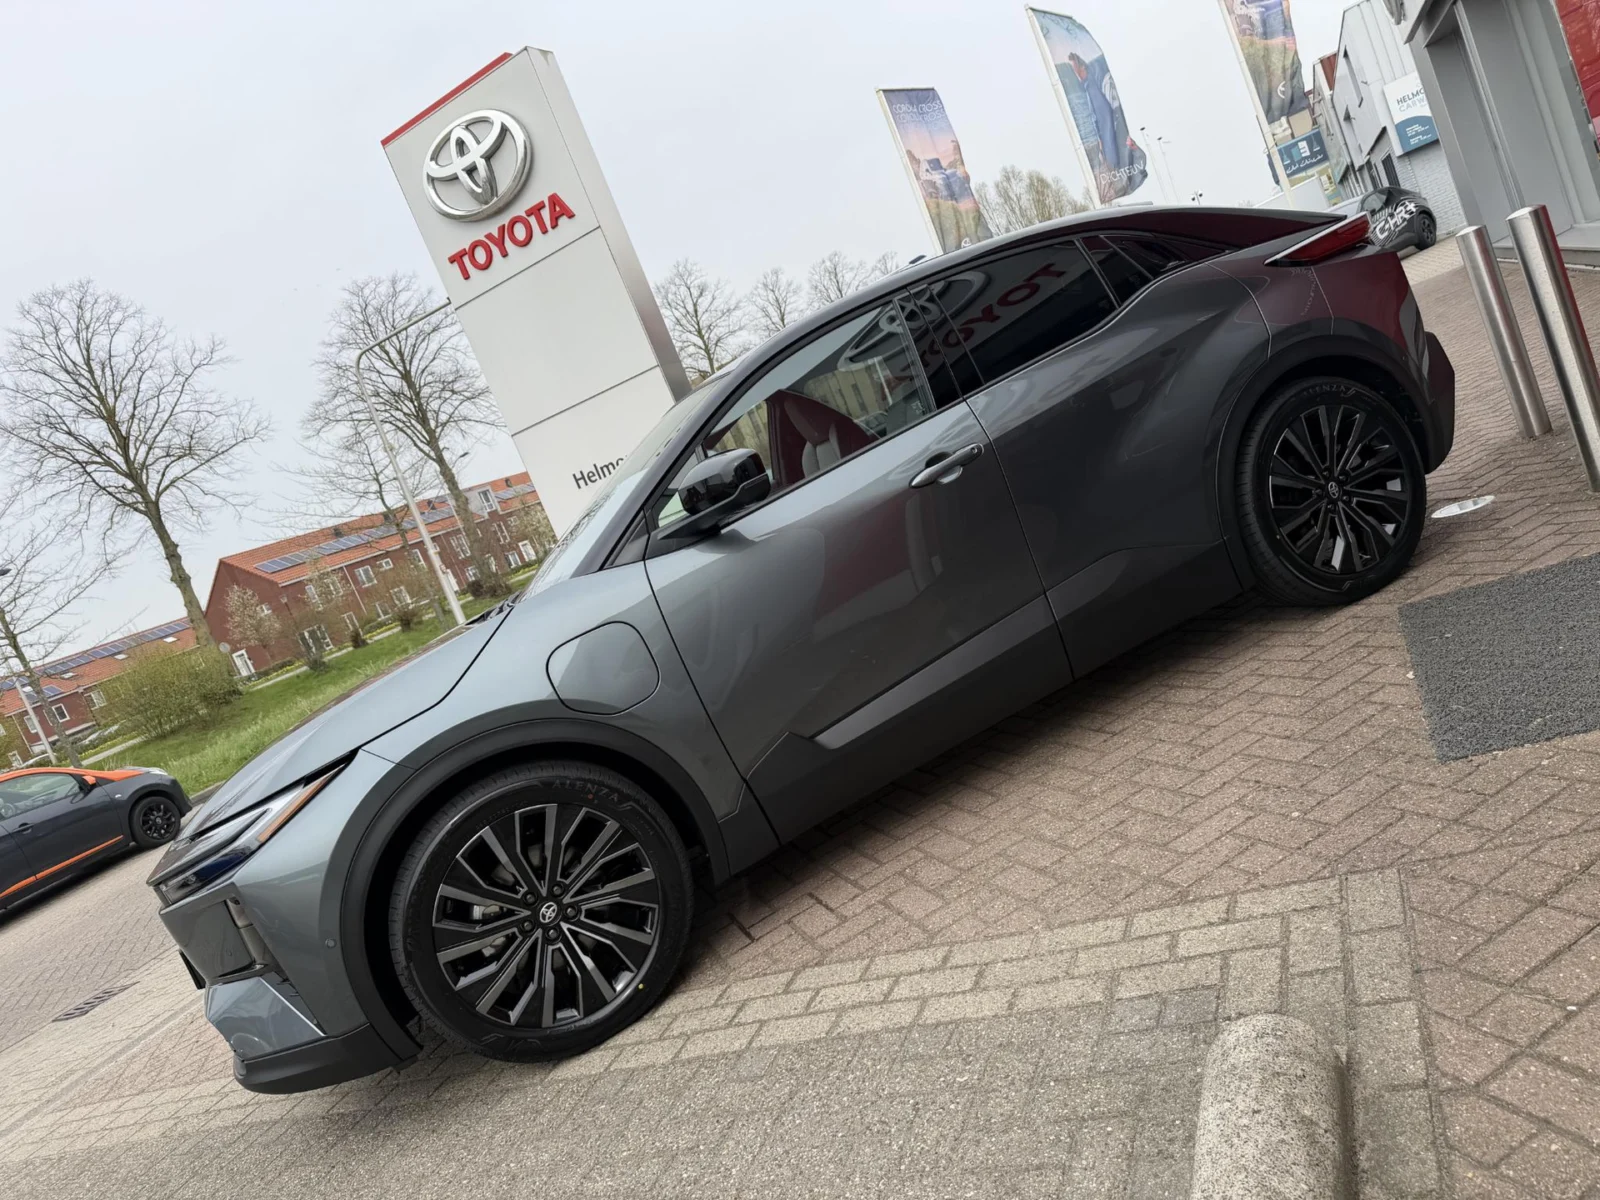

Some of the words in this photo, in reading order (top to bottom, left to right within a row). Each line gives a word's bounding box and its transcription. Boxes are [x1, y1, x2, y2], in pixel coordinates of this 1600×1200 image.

[918, 100, 942, 113] CROSS
[1399, 95, 1426, 112] CARW
[1376, 201, 1416, 239] C-HR+
[448, 192, 576, 281] TOYOTA
[552, 778, 620, 803] ALENZA
